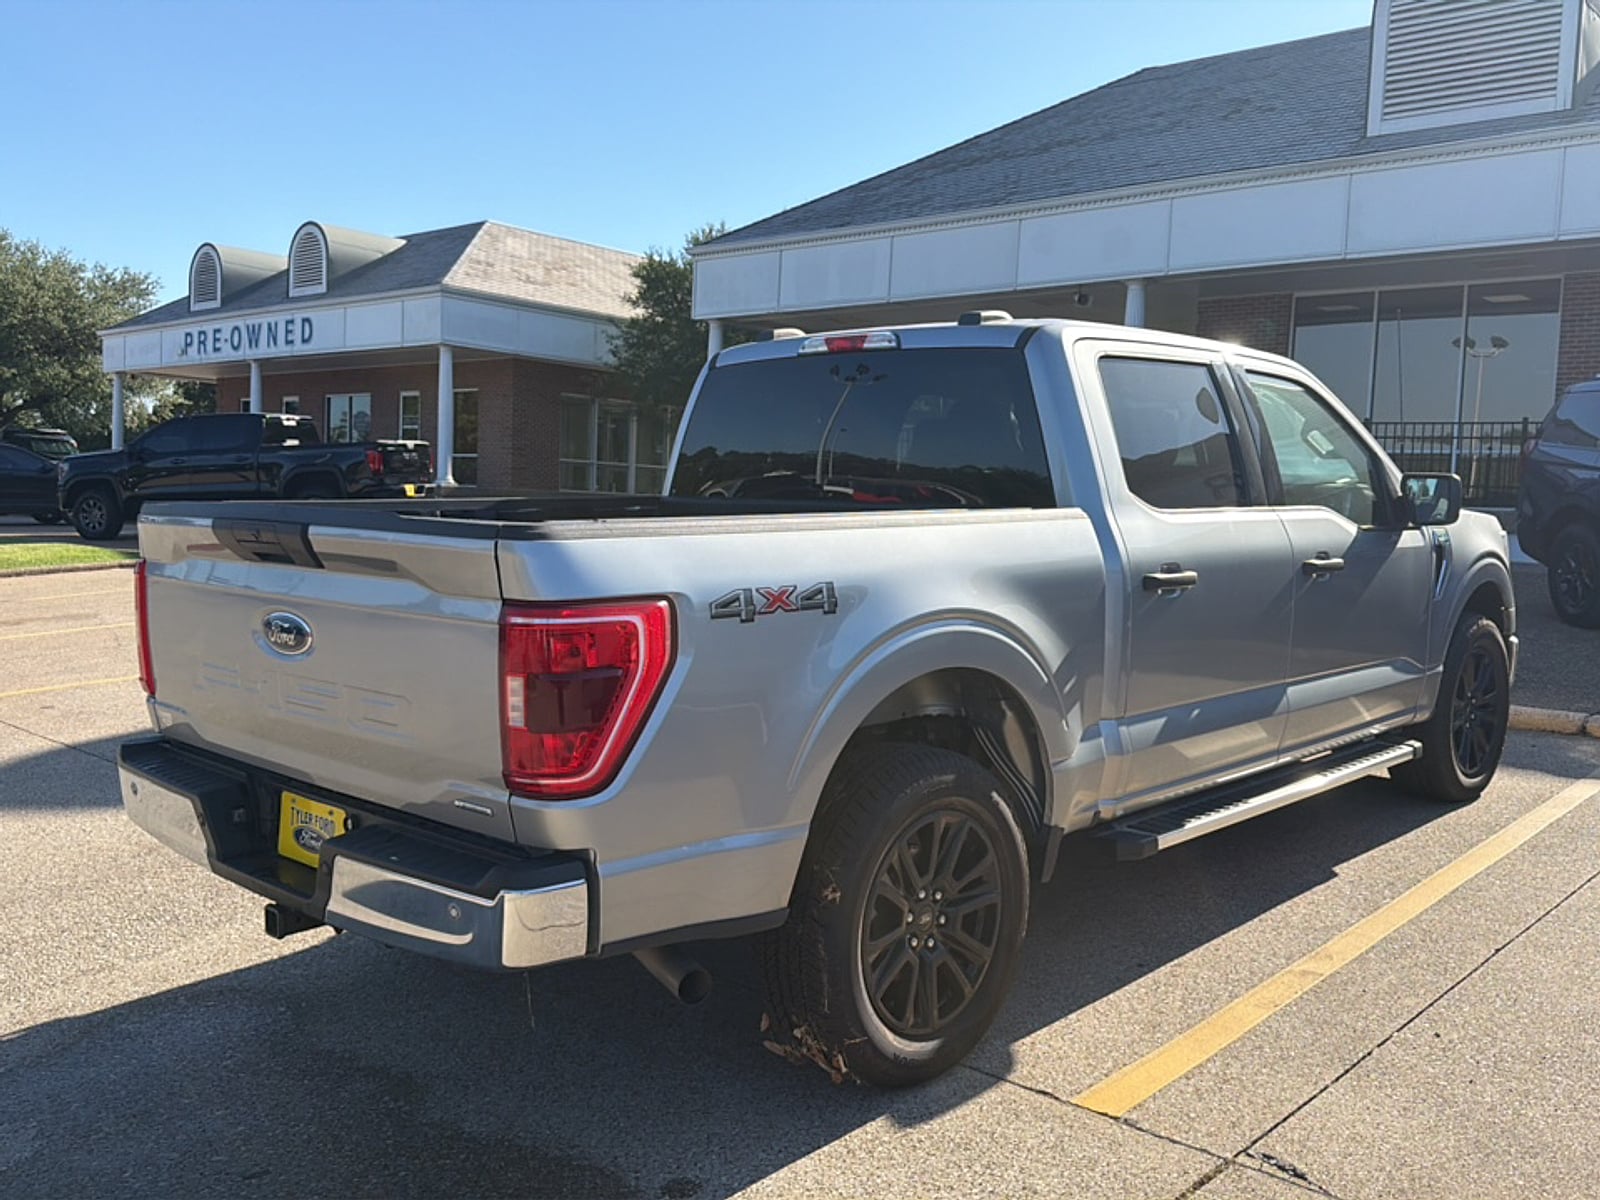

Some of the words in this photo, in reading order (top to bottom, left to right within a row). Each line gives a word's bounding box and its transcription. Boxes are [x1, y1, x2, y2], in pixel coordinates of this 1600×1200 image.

[184, 317, 313, 356] PRE-OWNED
[268, 620, 296, 646] Ford
[290, 806, 314, 827] TYLER
